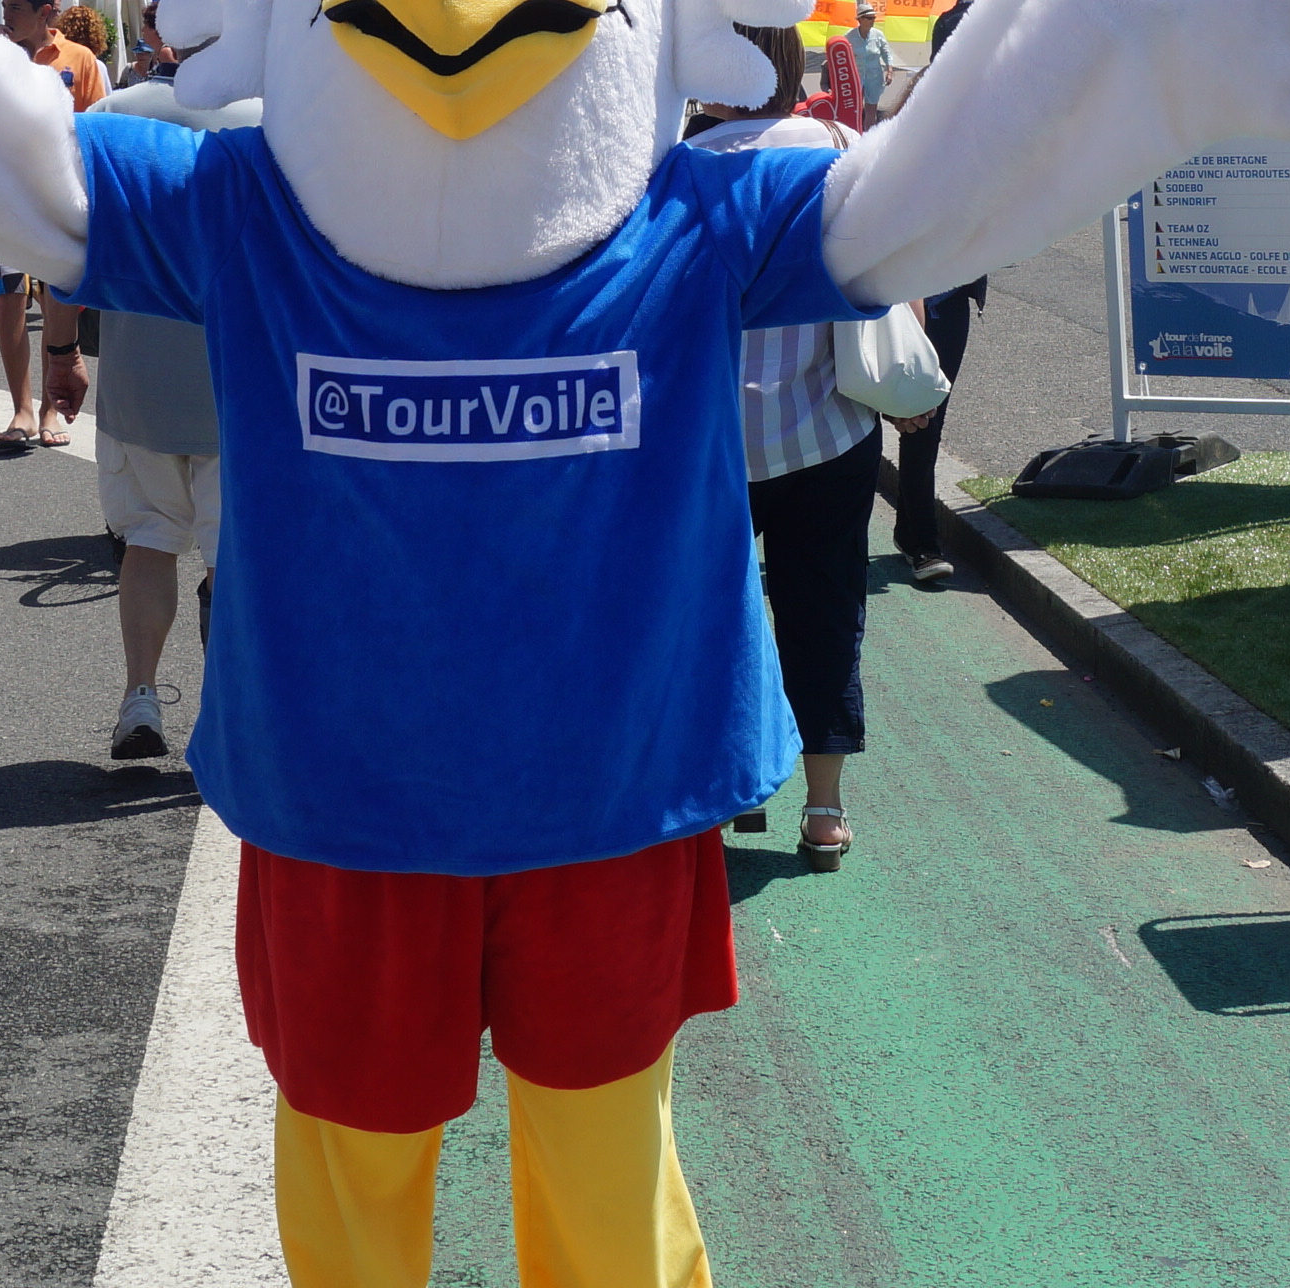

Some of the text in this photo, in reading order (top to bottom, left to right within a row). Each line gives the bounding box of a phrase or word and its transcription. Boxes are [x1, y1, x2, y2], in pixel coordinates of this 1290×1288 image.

[1202, 156, 1214, 165] DE
[1217, 156, 1267, 164] BRETAGNE
[1166, 170, 1290, 179] RADIO VINCI AUTOROUTES
[1166, 184, 1203, 192] SODEBO
[1166, 197, 1217, 206] SPINDRIFT
[1168, 224, 1194, 233] TEAM
[1168, 238, 1219, 247] TECHNEAU
[1168, 251, 1208, 260] VANNES
[1210, 252, 1241, 260] AGGLO
[1250, 252, 1279, 261] GOLFE
[1170, 265, 1196, 274] WEST
[1199, 265, 1249, 275] COURTAGE
[1257, 266, 1287, 275] ECOLE
[1165, 333, 1232, 342] tour france
[1194, 343, 1233, 357] voile
[314, 379, 616, 436] @TourVoile
